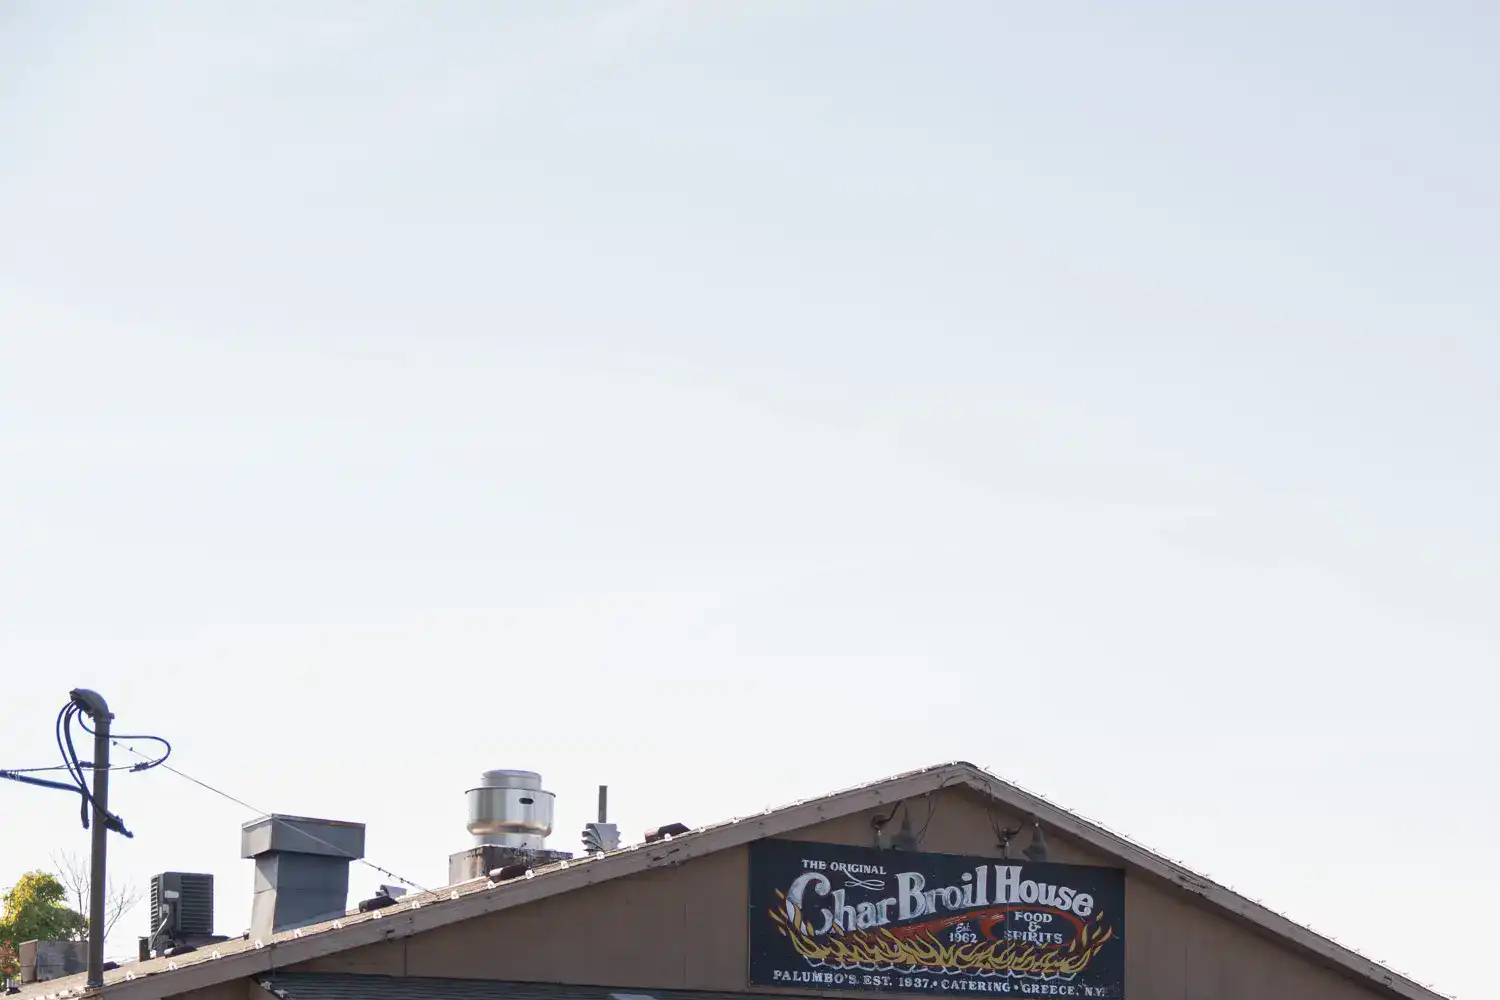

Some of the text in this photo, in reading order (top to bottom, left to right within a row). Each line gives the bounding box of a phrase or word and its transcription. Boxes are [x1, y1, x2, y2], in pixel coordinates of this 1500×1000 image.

[801, 859, 887, 875] THE ORIGINAL
[785, 864, 1094, 936] Char Broil House
[1014, 911, 1053, 922] FOOD
[955, 922, 972, 933] Est.
[1027, 920, 1042, 932] &
[949, 932, 978, 944] 1962
[1003, 930, 1063, 944] SPIRITS
[862, 975, 893, 987] EST.
[941, 979, 1011, 993] CATERING
[1022, 983, 1080, 996] GREECE,
